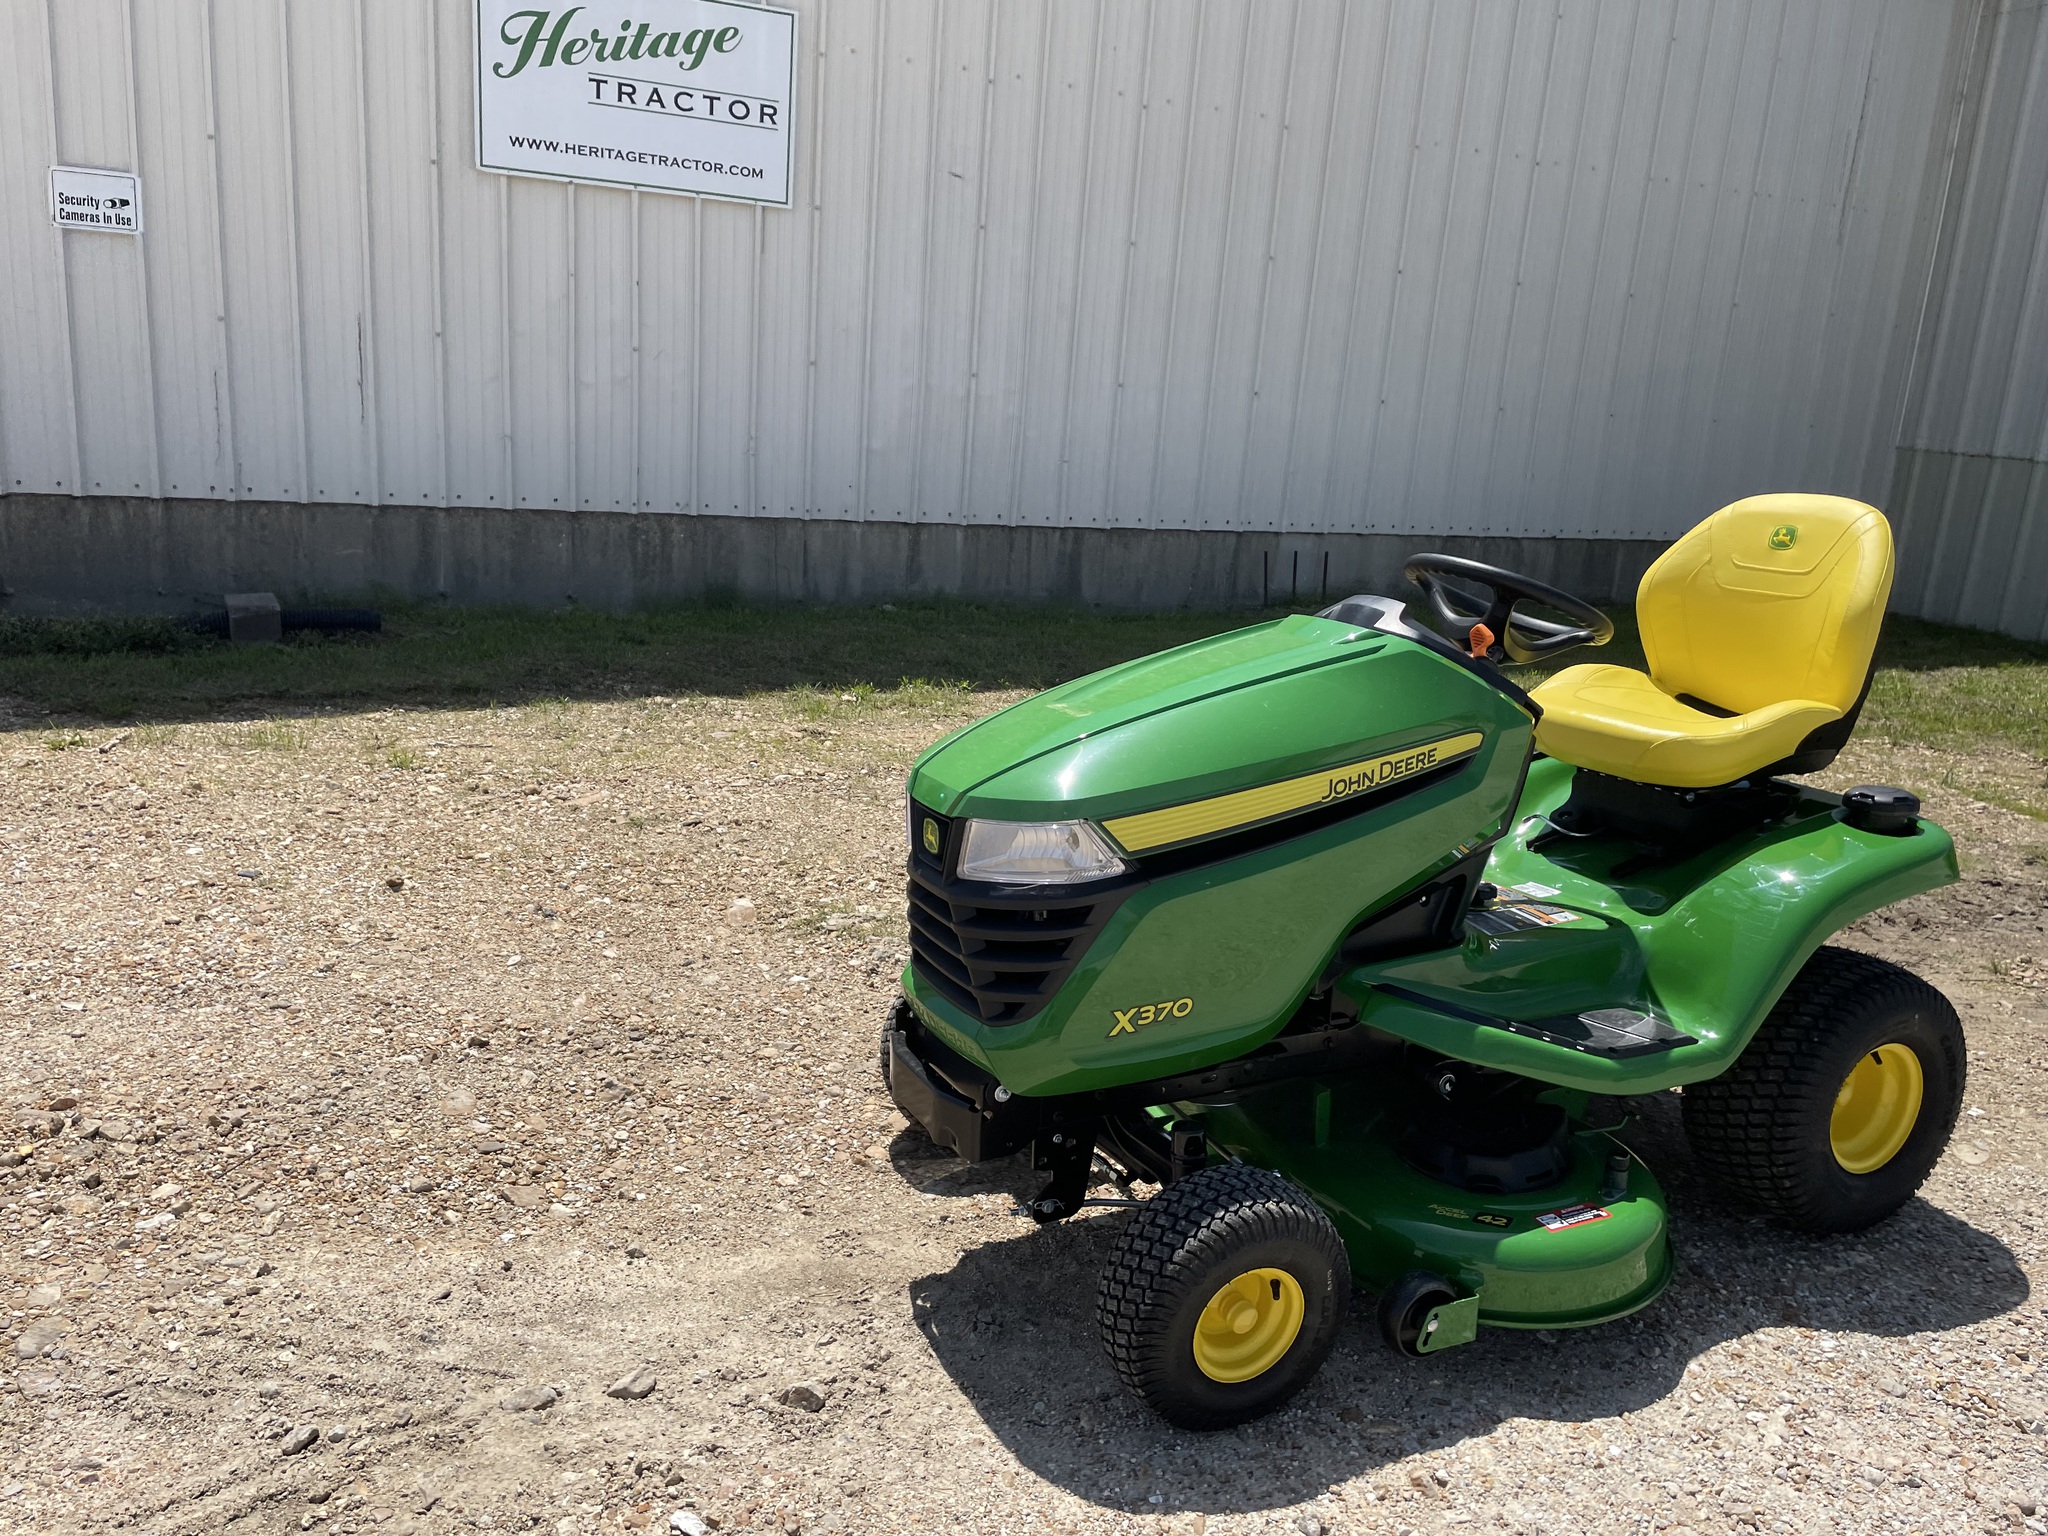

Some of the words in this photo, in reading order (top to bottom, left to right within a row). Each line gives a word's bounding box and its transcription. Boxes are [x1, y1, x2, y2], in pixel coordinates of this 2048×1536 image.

[493, 7, 743, 79] Heritage
[588, 77, 778, 126] TRACTOR
[509, 135, 764, 180] WWW.HERITAGETRACTOR.COM
[58, 192, 100, 210] Security
[59, 207, 101, 223] Cameras
[103, 211, 112, 224] In
[115, 213, 132, 227] Use
[1321, 768, 1375, 801] JOHN
[1379, 747, 1438, 782] DEERE
[1106, 997, 1194, 1038] X370
[1477, 1215, 1508, 1226] 42
